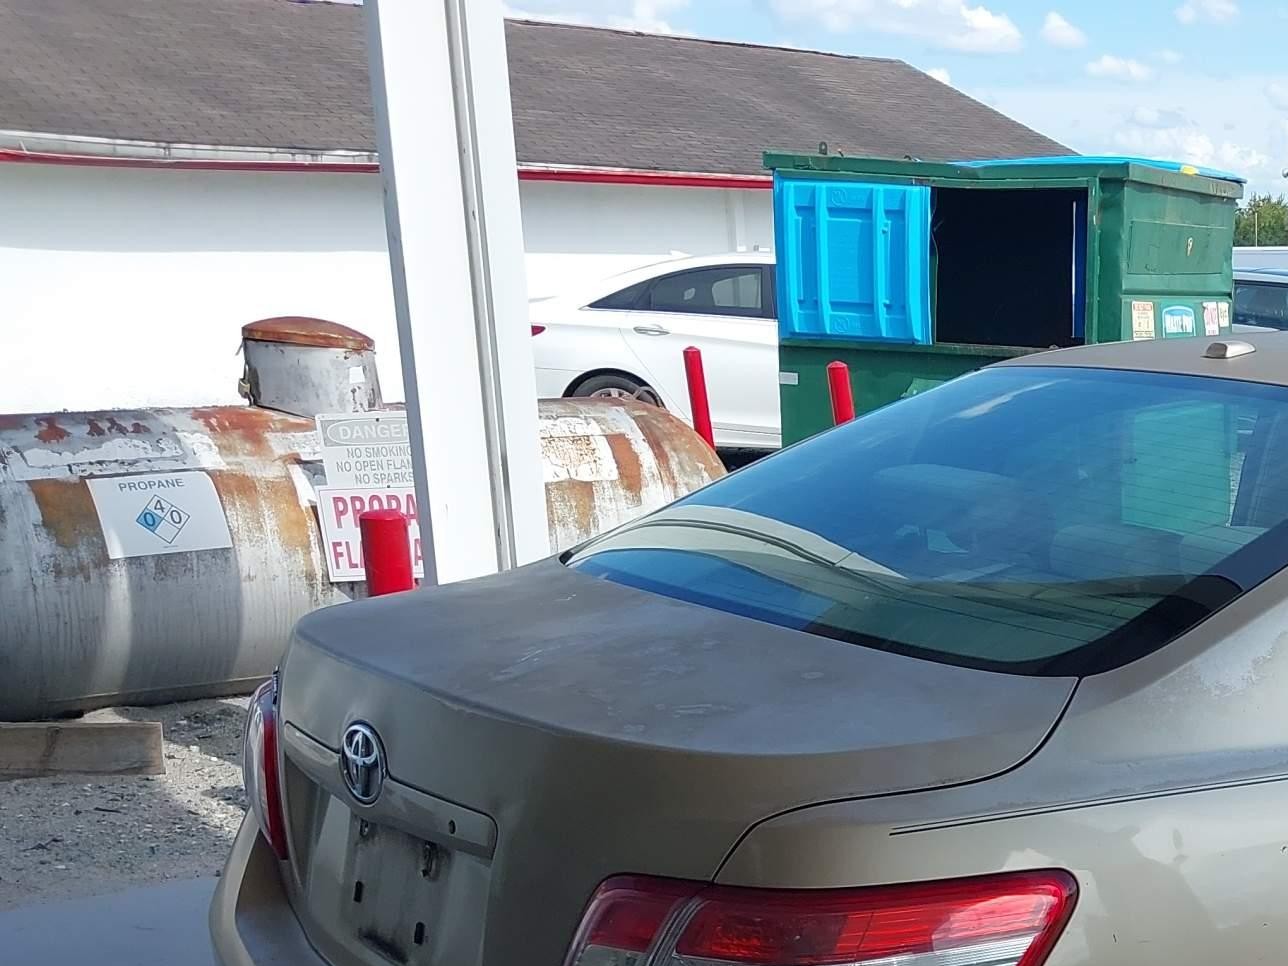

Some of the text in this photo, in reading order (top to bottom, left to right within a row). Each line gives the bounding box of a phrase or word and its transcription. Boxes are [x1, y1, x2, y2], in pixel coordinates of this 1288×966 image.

[346, 447, 362, 459] NO
[336, 458, 413, 473] NO OPEN FLA
[118, 478, 185, 492] PROPANE
[354, 473, 371, 485] NO
[154, 499, 165, 513] 4
[332, 493, 419, 529] PROPA
[143, 511, 156, 527] 0
[170, 509, 182, 525] 0
